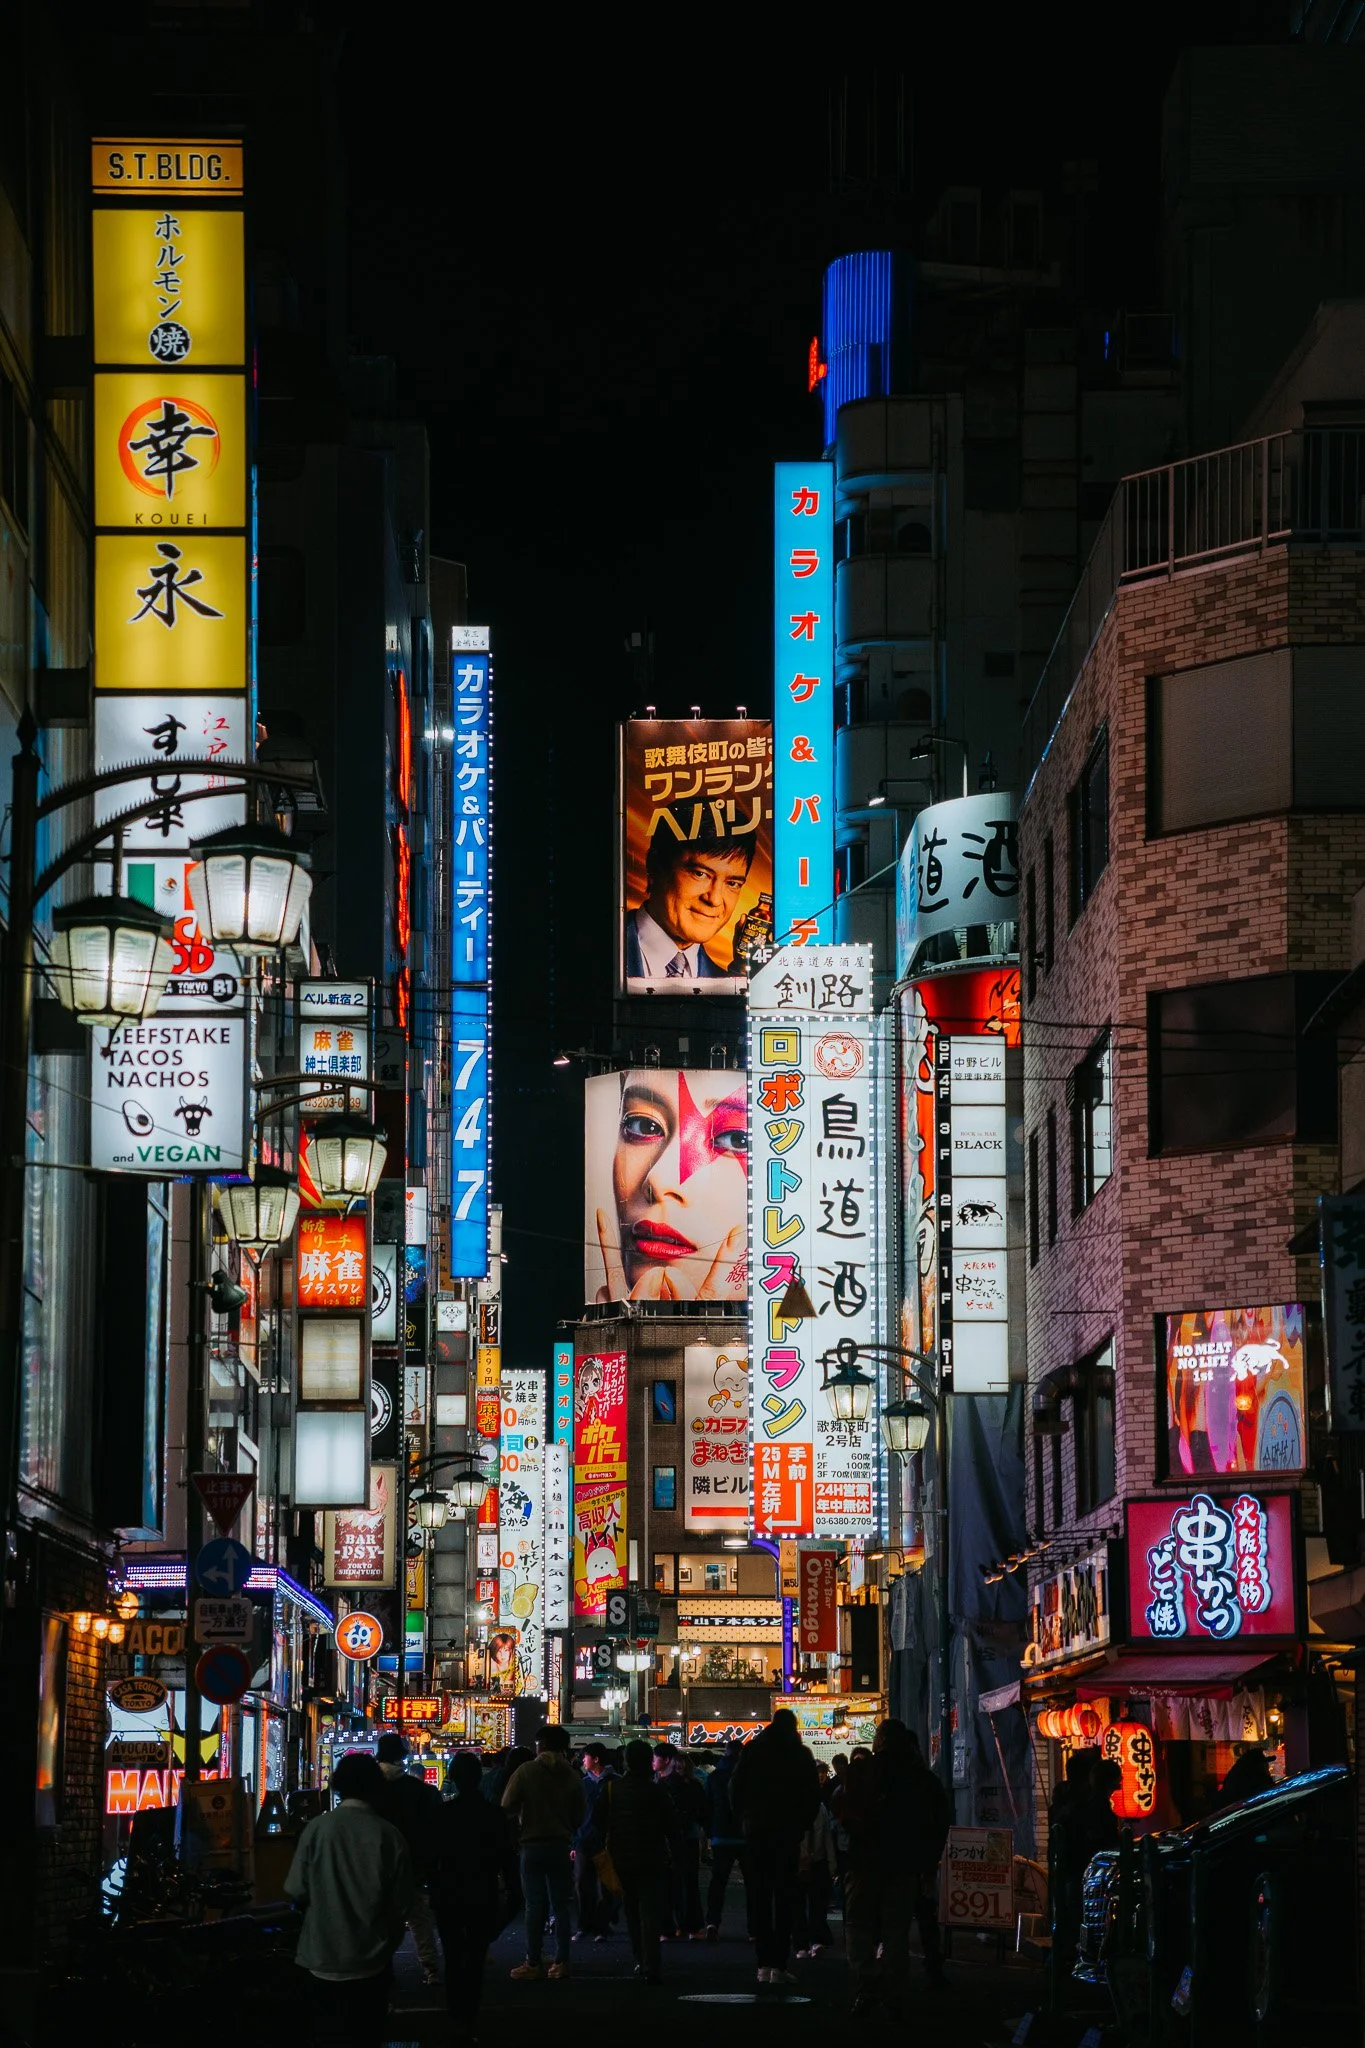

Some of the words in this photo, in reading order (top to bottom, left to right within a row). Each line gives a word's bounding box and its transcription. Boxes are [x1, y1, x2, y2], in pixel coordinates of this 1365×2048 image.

[108, 152, 231, 182] S.T.BLDG.
[150, 212, 189, 361] ホルモン焼
[128, 400, 216, 500] 幸
[135, 513, 208, 526] KOUEI
[127, 543, 225, 629] 永
[456, 664, 486, 962] カラオケ&パーティー
[646, 796, 772, 841] ヘパリ
[752, 948, 773, 963] 4F
[777, 956, 865, 968] 北海道居酒屋
[774, 972, 863, 1010] 釧路
[313, 1030, 354, 1051] 麻雀
[109, 1050, 183, 1065] TACOS
[954, 1057, 1002, 1068] 中野ビル
[107, 1071, 209, 1088] NACHOS
[454, 1039, 485, 1222] 747
[955, 1140, 1003, 1150] BLACK
[112, 1153, 134, 1162] and
[137, 1145, 221, 1163] VEGAN
[313, 1234, 352, 1248] リーチ
[298, 1249, 364, 1282] 麻雀
[302, 1282, 362, 1294] プラスワン
[487, 1305, 498, 1336] ダーツ
[1173, 1345, 1193, 1358] NO
[1194, 1341, 1233, 1356] MEAT
[1178, 1358, 1198, 1369] NO
[1198, 1355, 1229, 1368] LIFE
[1193, 1370, 1214, 1382] 1st
[479, 1403, 499, 1433] 麻雀
[826, 1435, 862, 1447] 2号店
[692, 1438, 748, 1466] まねき
[788, 1446, 807, 1480] 手前
[817, 1470, 828, 1478] 3F
[206, 1481, 244, 1494] 止まれ
[692, 1476, 748, 1494] 隣ビル
[816, 1484, 870, 1497] 24H営業
[816, 1498, 870, 1513] 年中無休
[577, 1503, 621, 1532] 高収入
[816, 1517, 872, 1525] 03-6380-2709
[345, 1534, 377, 1544] BAR
[584, 1522, 625, 1550] バイト
[342, 1545, 379, 1559] PSY
[1238, 1500, 1260, 1607] 大阪名物
[1177, 1502, 1233, 1631] 串かつ
[1150, 1542, 1177, 1632] どて焼
[582, 1593, 607, 1609] プレゼ
[803, 1558, 822, 1644] Orange
[200, 1616, 248, 1628] 一方通行
[694, 1617, 796, 1626] 山下本気うど
[347, 1626, 372, 1648] 69
[114, 1683, 132, 1698] CASA
[135, 1682, 164, 1697] TEQUILA
[125, 1700, 152, 1708] TOKYO
[949, 1890, 1002, 1919] 891
